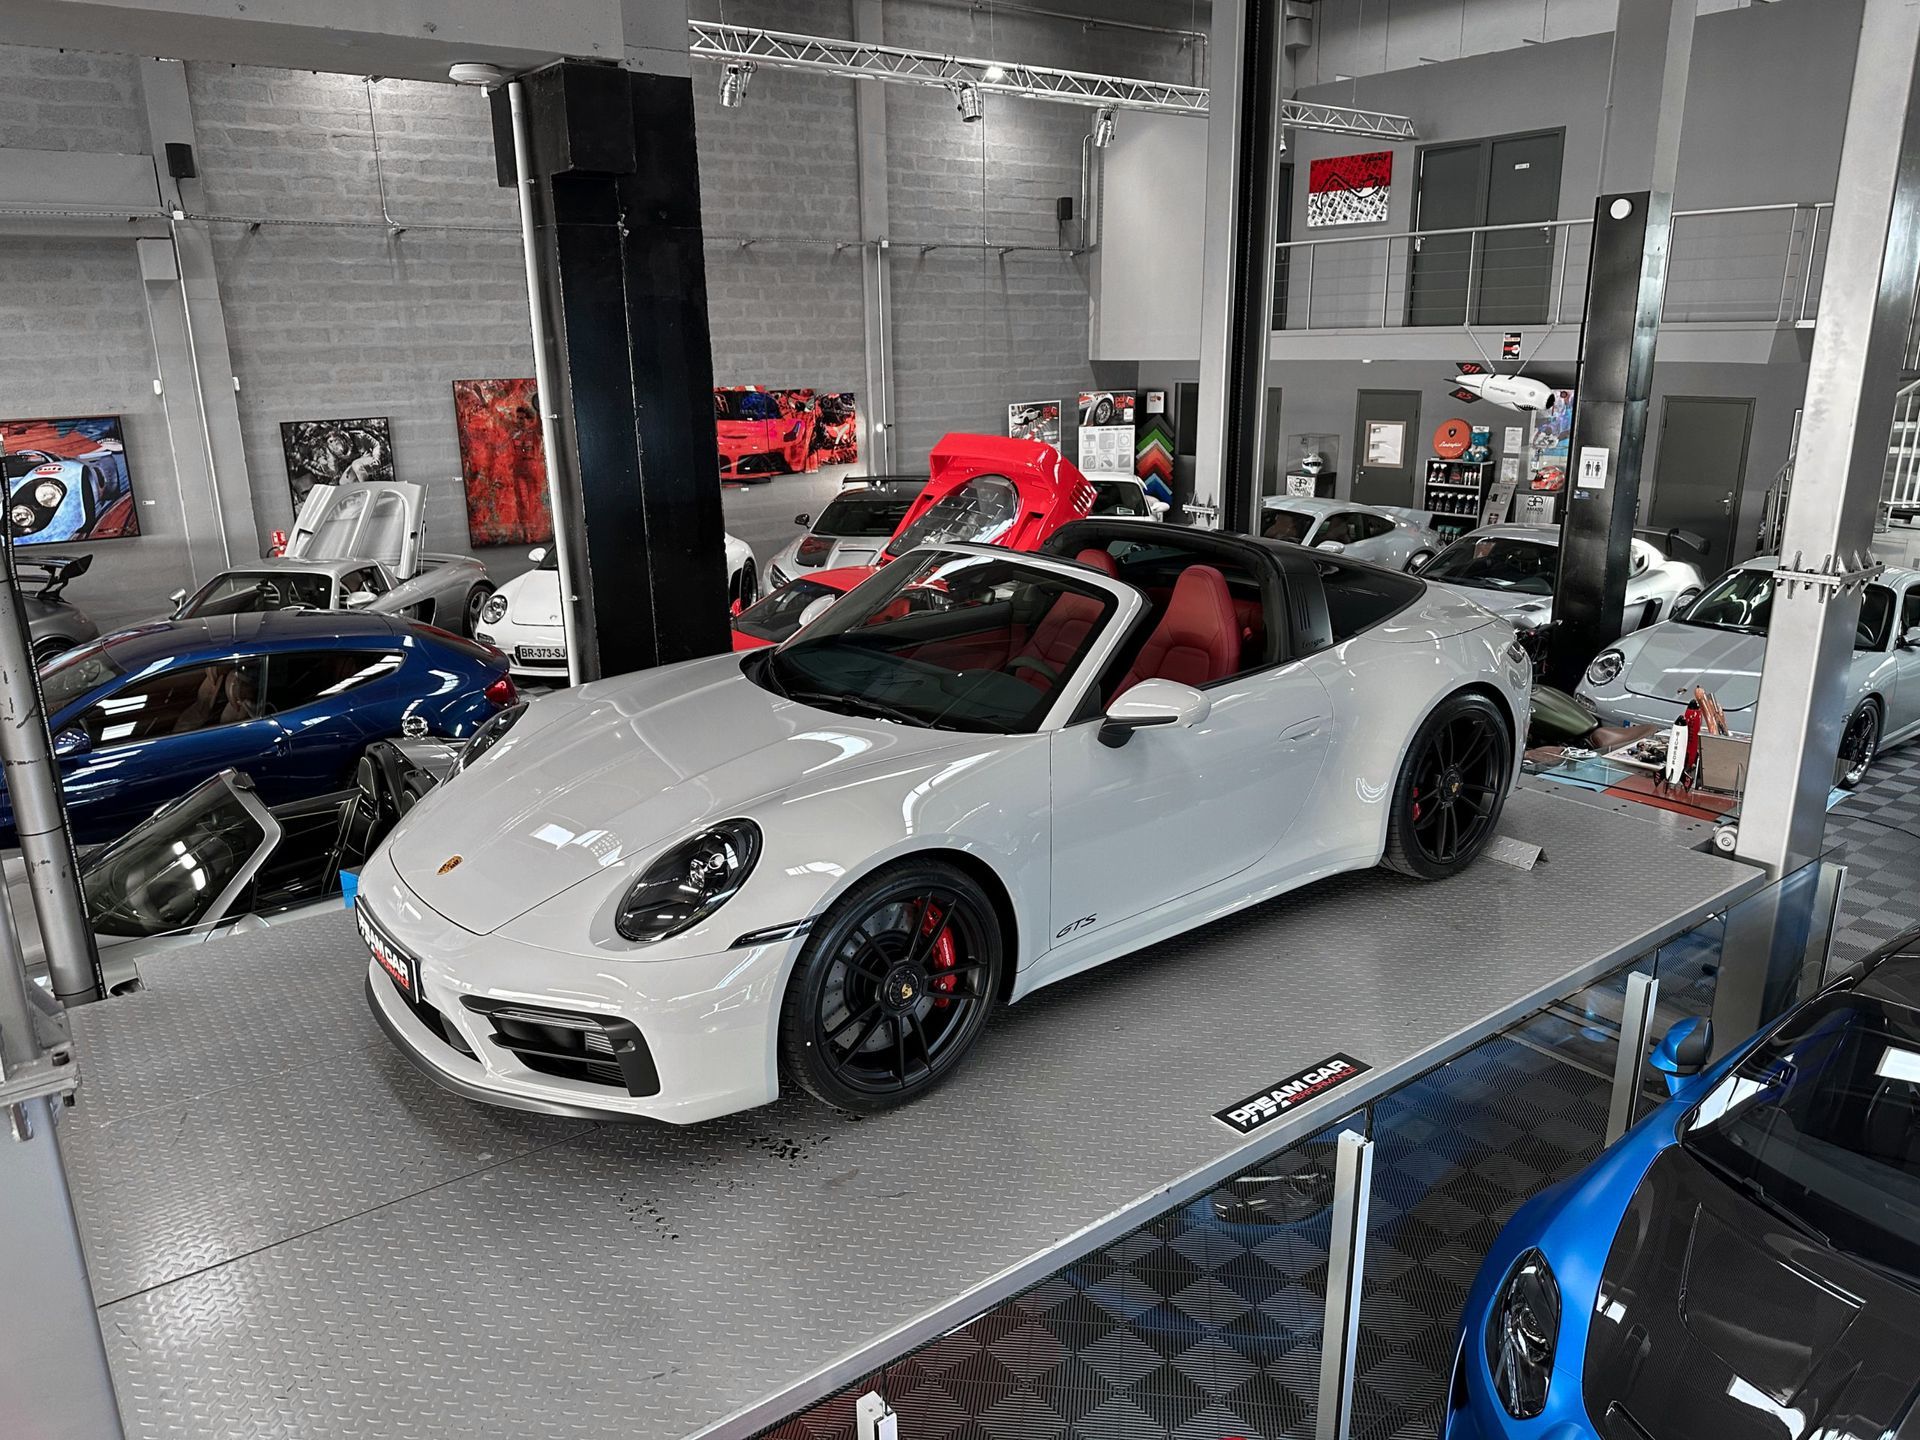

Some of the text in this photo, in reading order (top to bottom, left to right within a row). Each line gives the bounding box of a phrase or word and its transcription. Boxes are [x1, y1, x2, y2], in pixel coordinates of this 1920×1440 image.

[1462, 363, 1481, 374] 911
[521, 648, 566, 658] BR-373-SJ
[1056, 913, 1097, 938] GTS
[384, 945, 409, 982] CAR
[1227, 1059, 1350, 1123] DREAM CAR
[1288, 1066, 1358, 1103] PERFORMANCE
